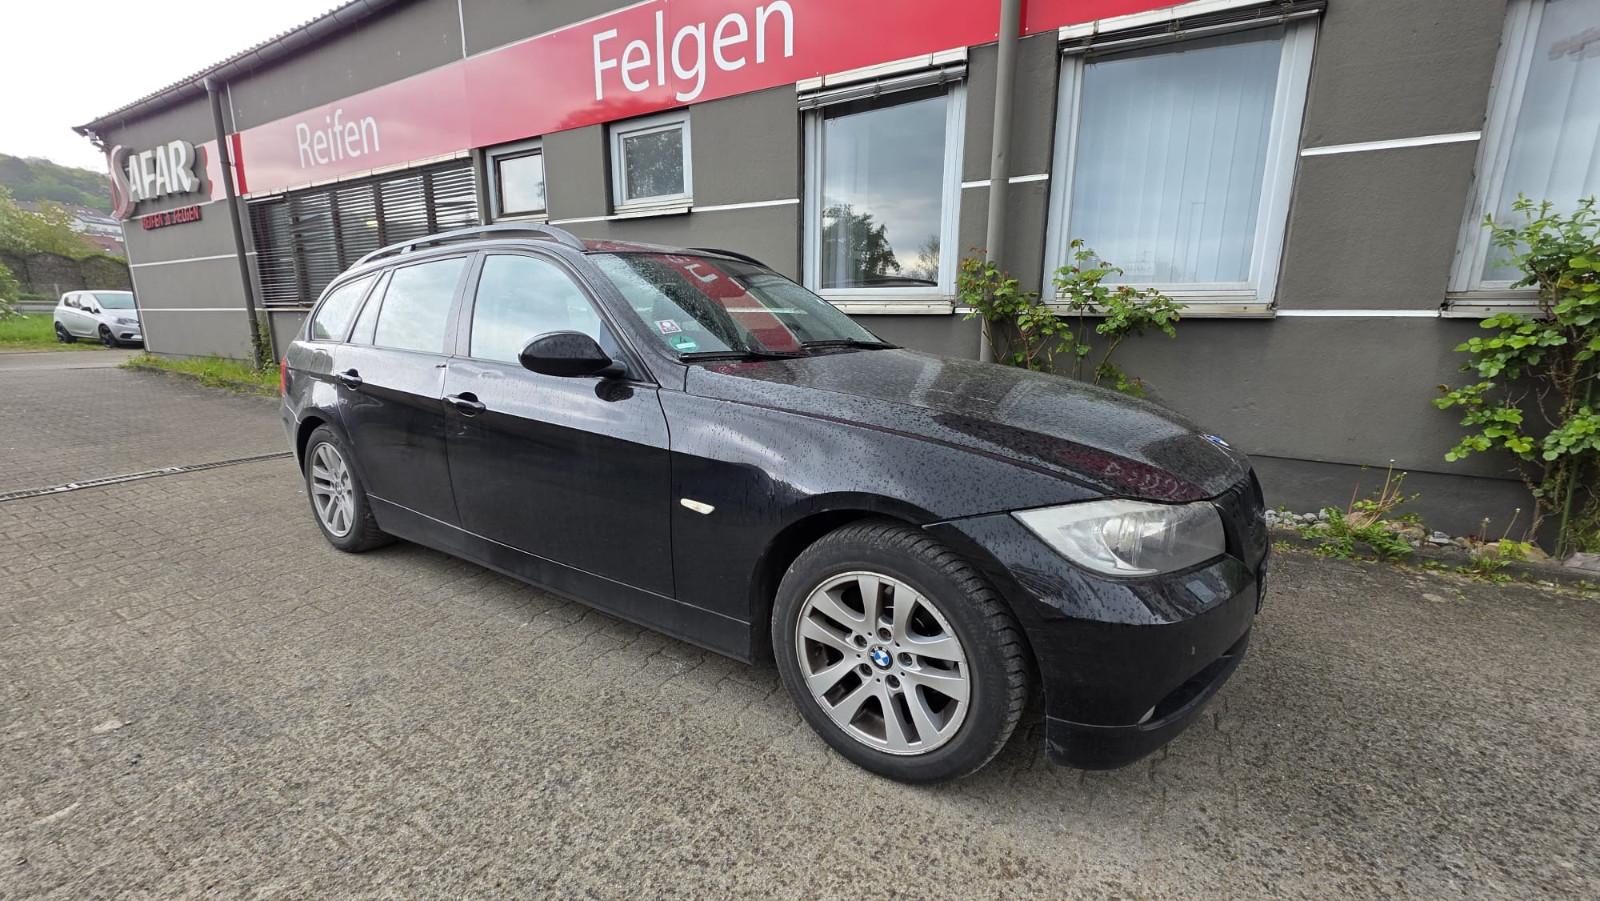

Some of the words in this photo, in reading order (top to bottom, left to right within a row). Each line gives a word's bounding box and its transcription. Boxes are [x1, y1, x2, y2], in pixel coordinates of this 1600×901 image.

[592, 0, 794, 103] Felgen
[110, 139, 198, 220] SAFAR
[296, 109, 380, 169] Reifen
